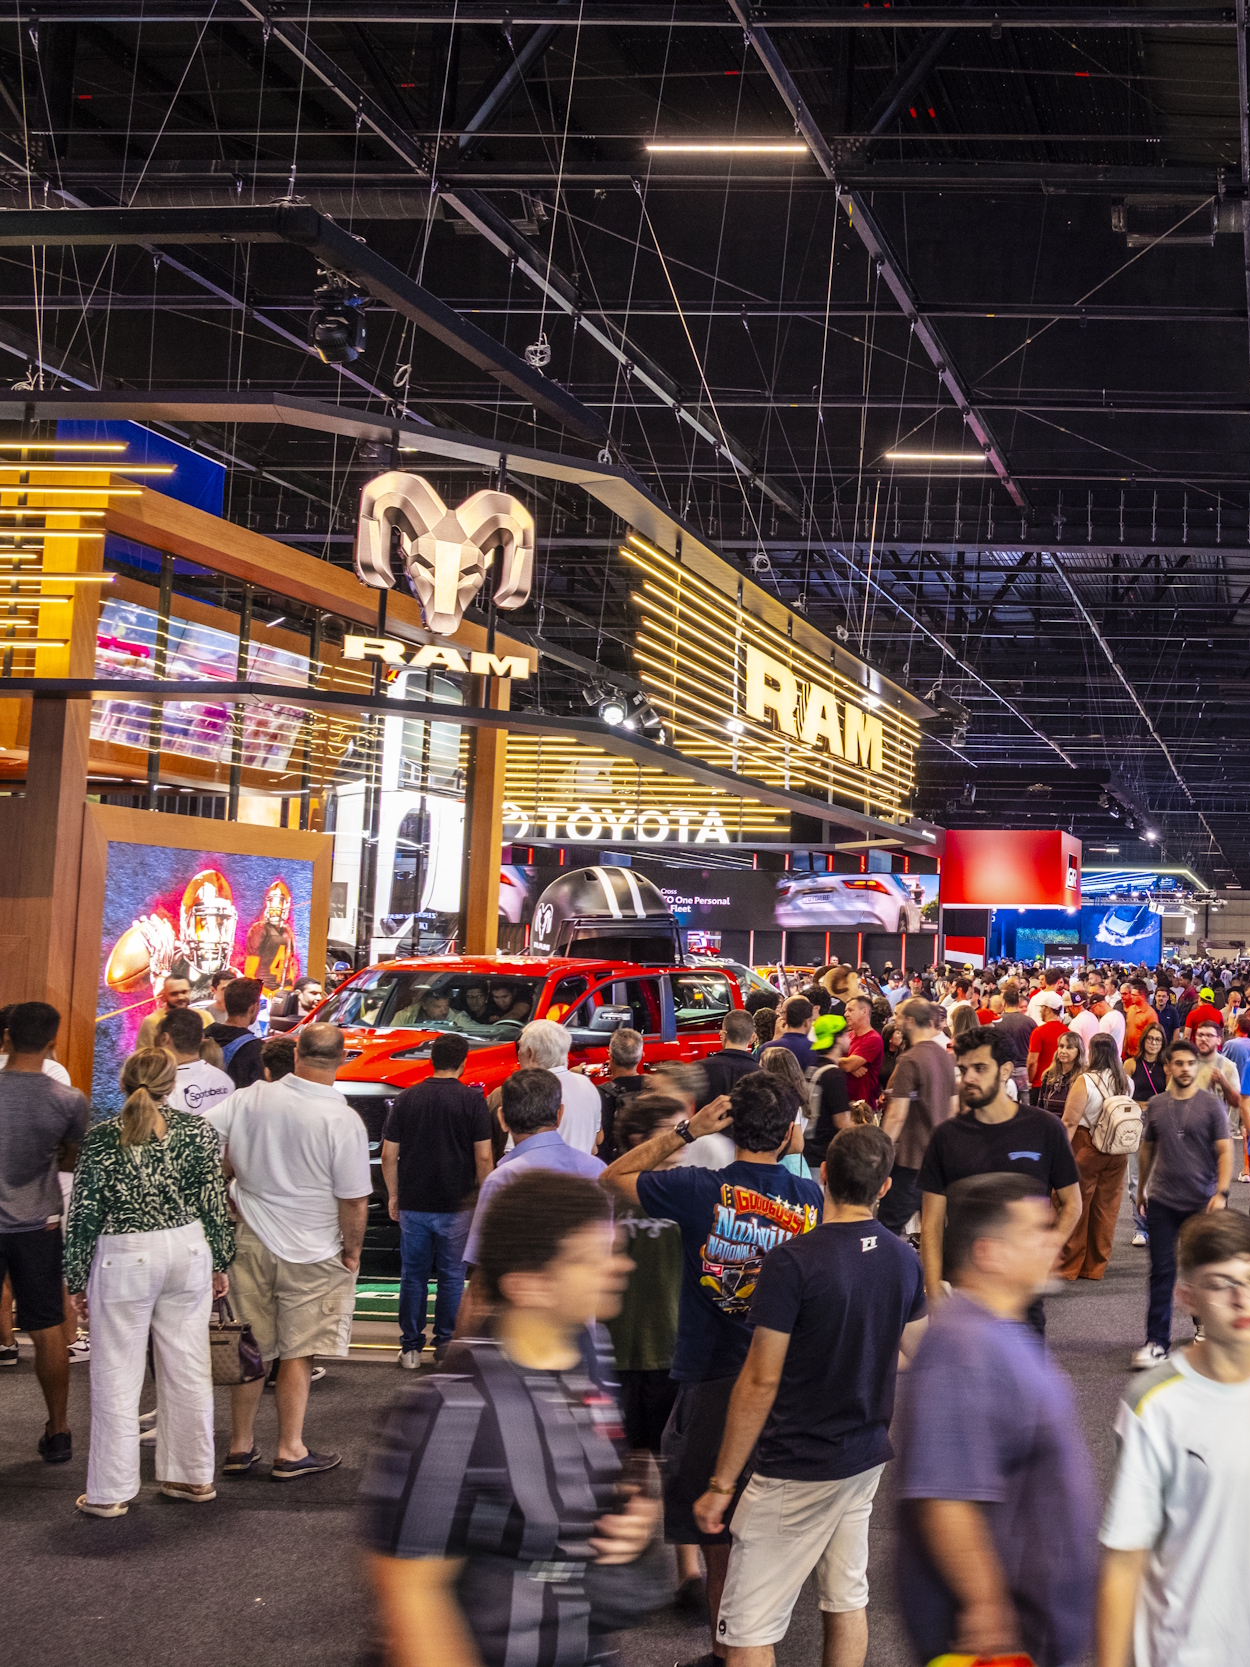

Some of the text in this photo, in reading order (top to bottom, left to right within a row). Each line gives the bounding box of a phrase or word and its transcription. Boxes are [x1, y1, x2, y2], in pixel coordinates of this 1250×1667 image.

[344, 634, 530, 680] RAM
[745, 644, 884, 774] RAM
[537, 806, 730, 843] TOYOTA
[670, 904, 692, 913] Fleet
[675, 896, 694, 904] One
[694, 896, 731, 905] Personal
[533, 941, 551, 951] RAM
[715, 1204, 793, 1253] Nashvil
[706, 1235, 758, 1260] NATIONALS
